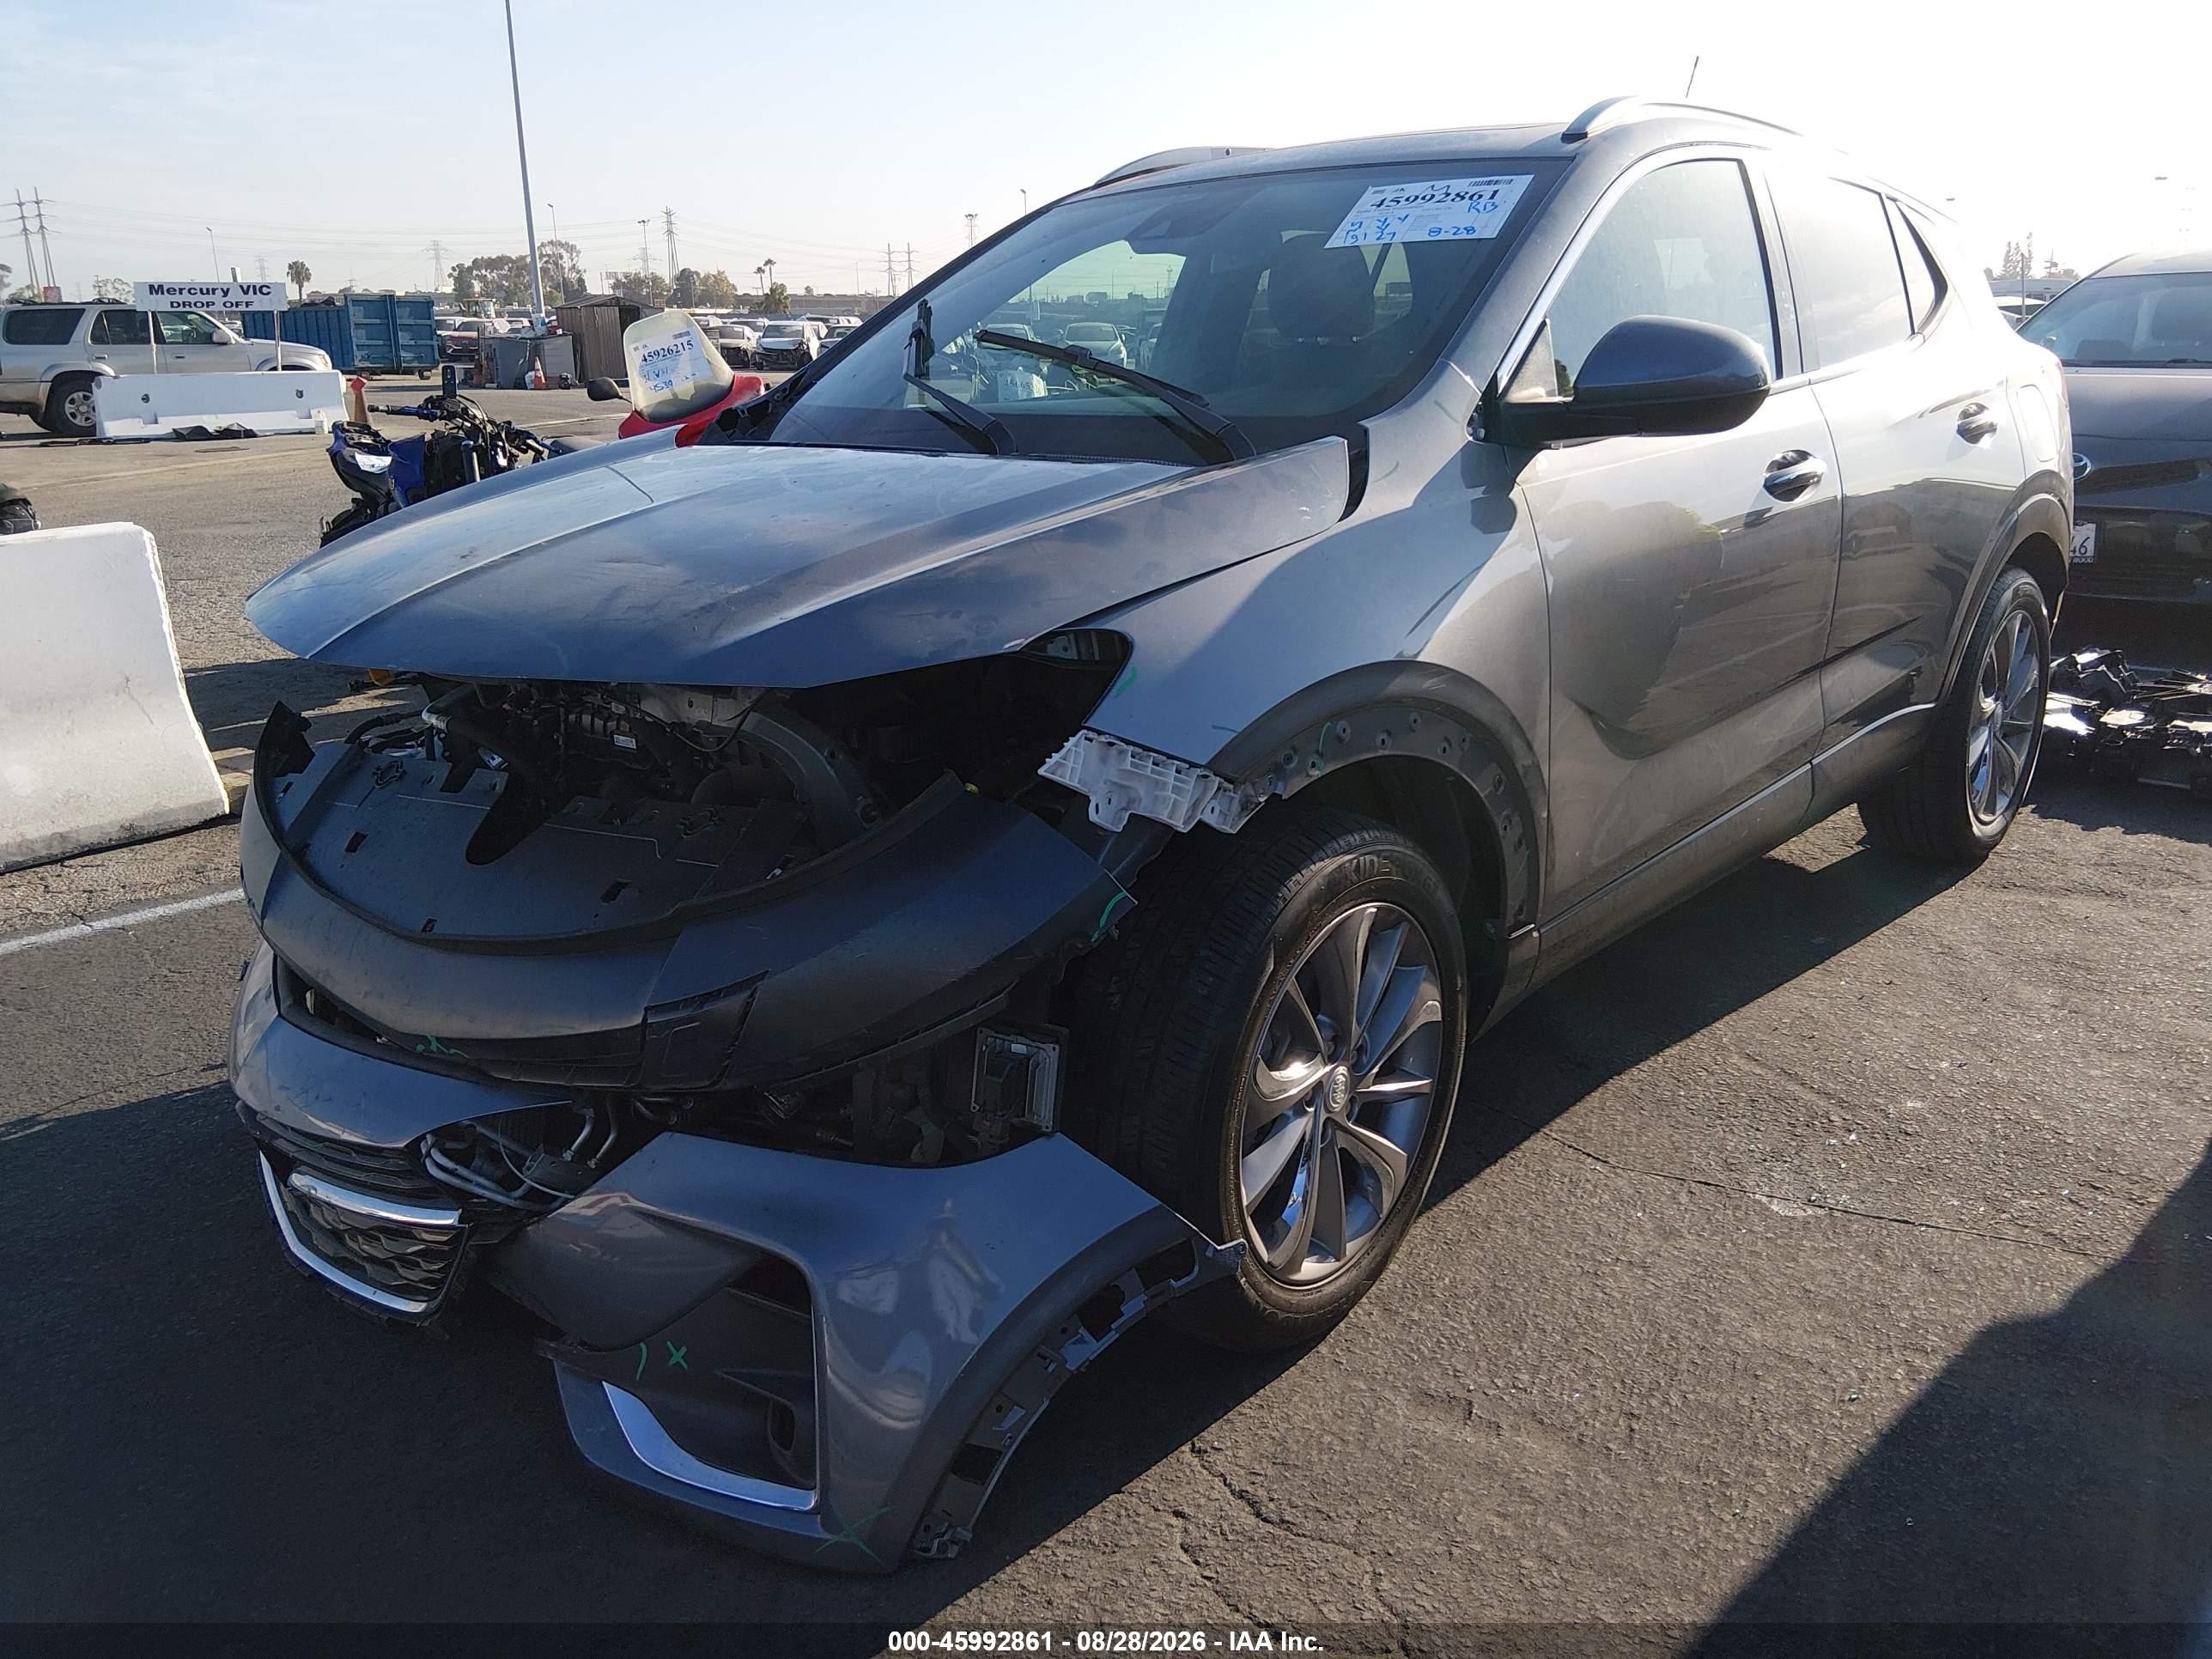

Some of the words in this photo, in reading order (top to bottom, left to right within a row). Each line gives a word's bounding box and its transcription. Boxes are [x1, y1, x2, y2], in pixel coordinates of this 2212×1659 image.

[1370, 188, 1500, 209] 45992861
[149, 284, 230, 297] Mercury
[240, 284, 272, 296] VIC
[641, 339, 694, 363] 45926215
